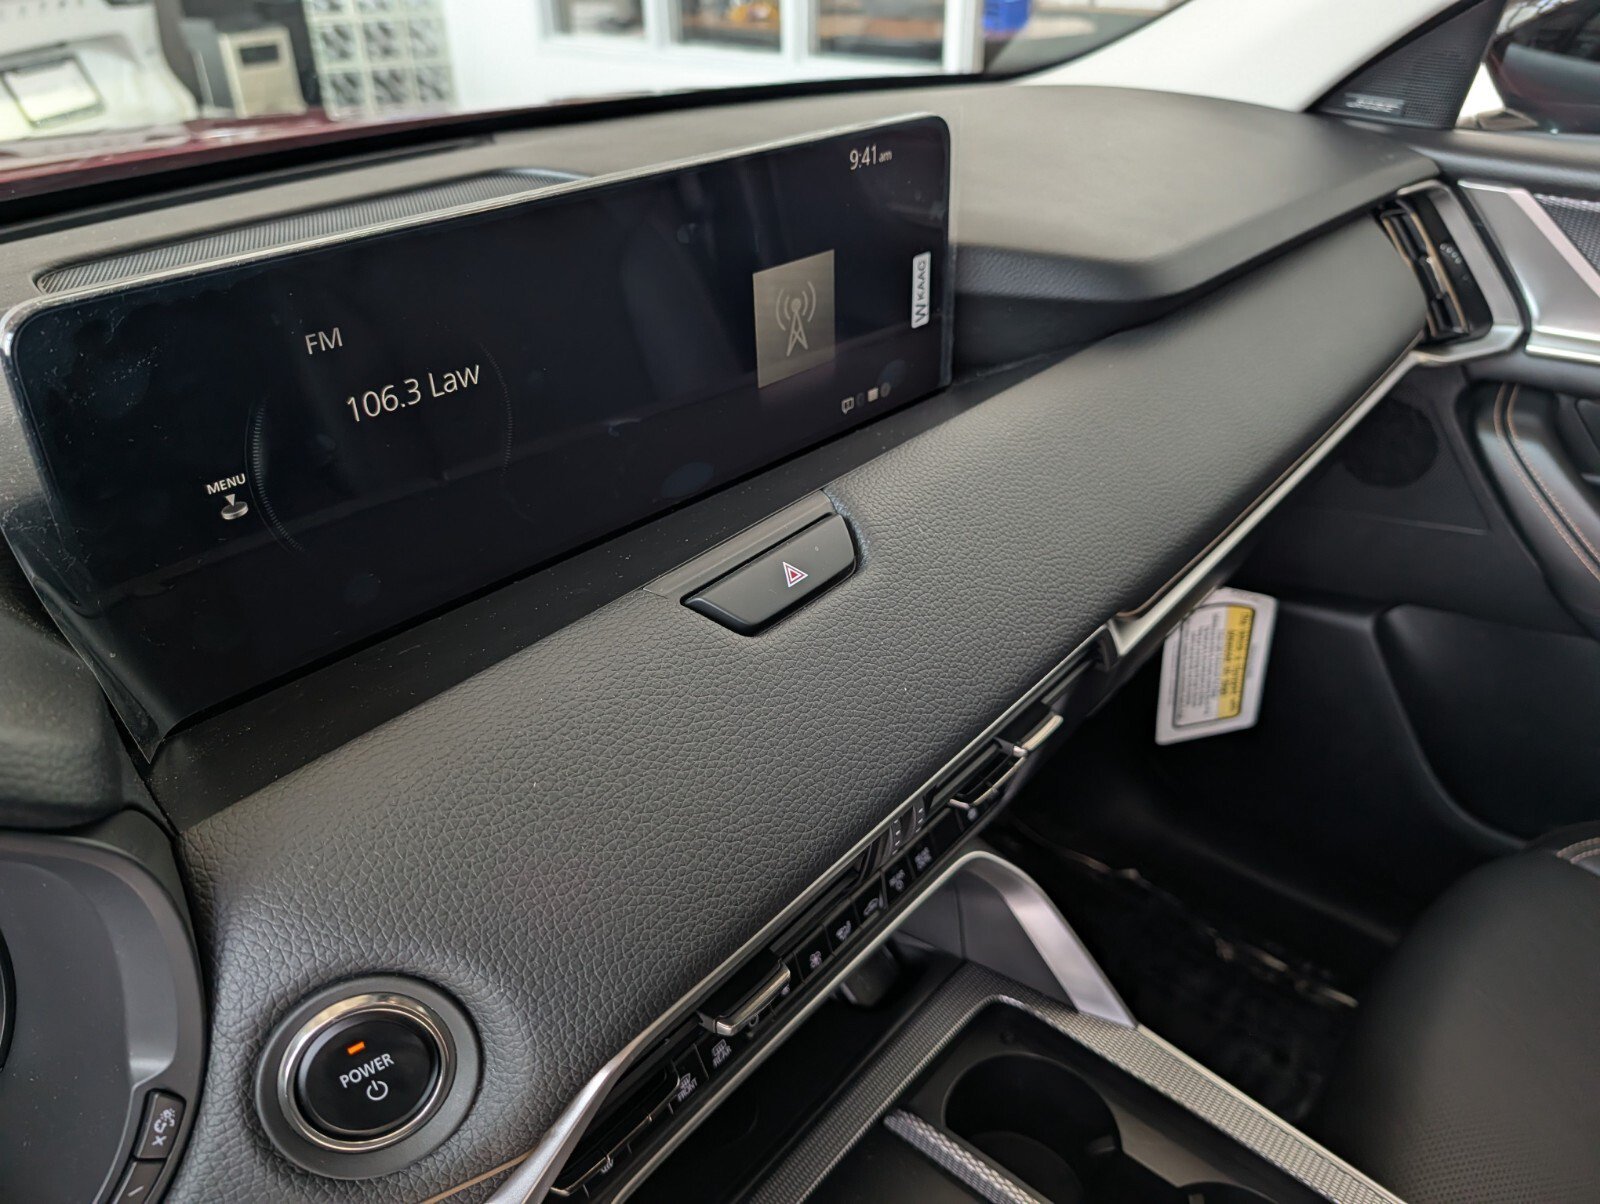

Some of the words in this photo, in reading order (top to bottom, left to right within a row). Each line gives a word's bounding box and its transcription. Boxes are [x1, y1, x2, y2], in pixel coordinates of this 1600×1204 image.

[305, 327, 342, 355] FM
[346, 377, 422, 422] 106.3
[428, 364, 480, 398] Law
[206, 473, 246, 496] MENU
[712, 1045, 732, 1068] REAR
[339, 1053, 395, 1089] POWER
[677, 1077, 698, 1102] FRONT
